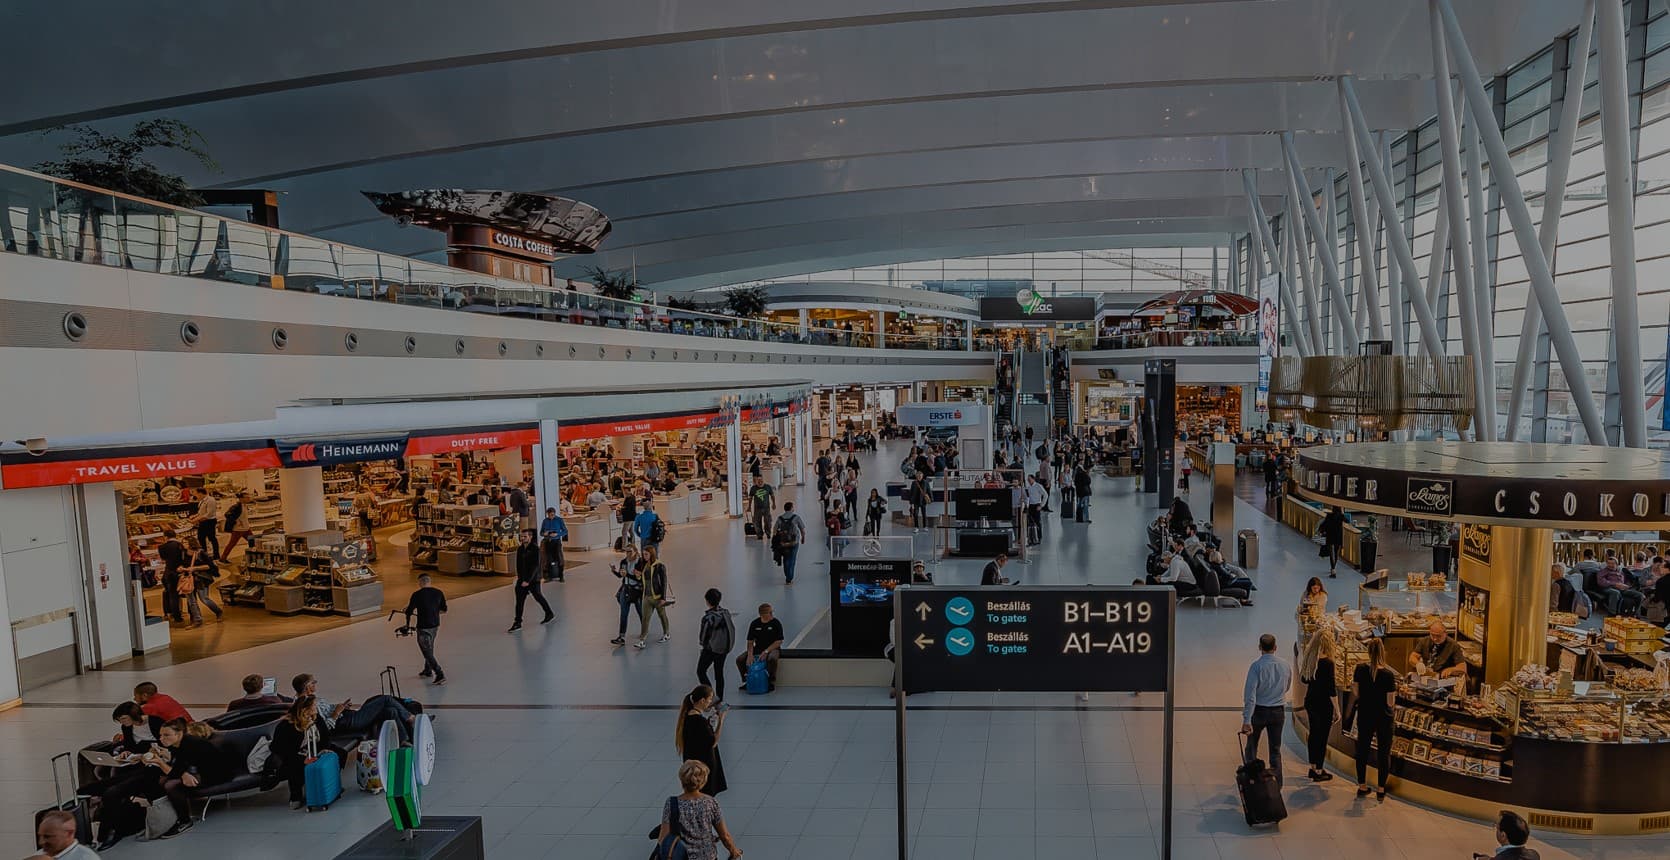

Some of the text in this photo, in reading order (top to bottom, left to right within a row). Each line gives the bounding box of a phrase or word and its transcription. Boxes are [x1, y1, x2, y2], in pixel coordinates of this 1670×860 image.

[496, 232, 553, 256] COSTA COFFEE
[929, 412, 953, 420] ERSTE
[614, 423, 651, 433] TRAVEL VALUE
[451, 435, 499, 448] DUTY FREE
[76, 458, 197, 477] TRAVEL VALUE
[847, 562, 894, 571] Mercedes-Benz
[987, 601, 1031, 612] Beszállás
[987, 614, 1027, 625] To gates
[987, 632, 1029, 642] Beszállás
[987, 644, 1027, 655] To gates
